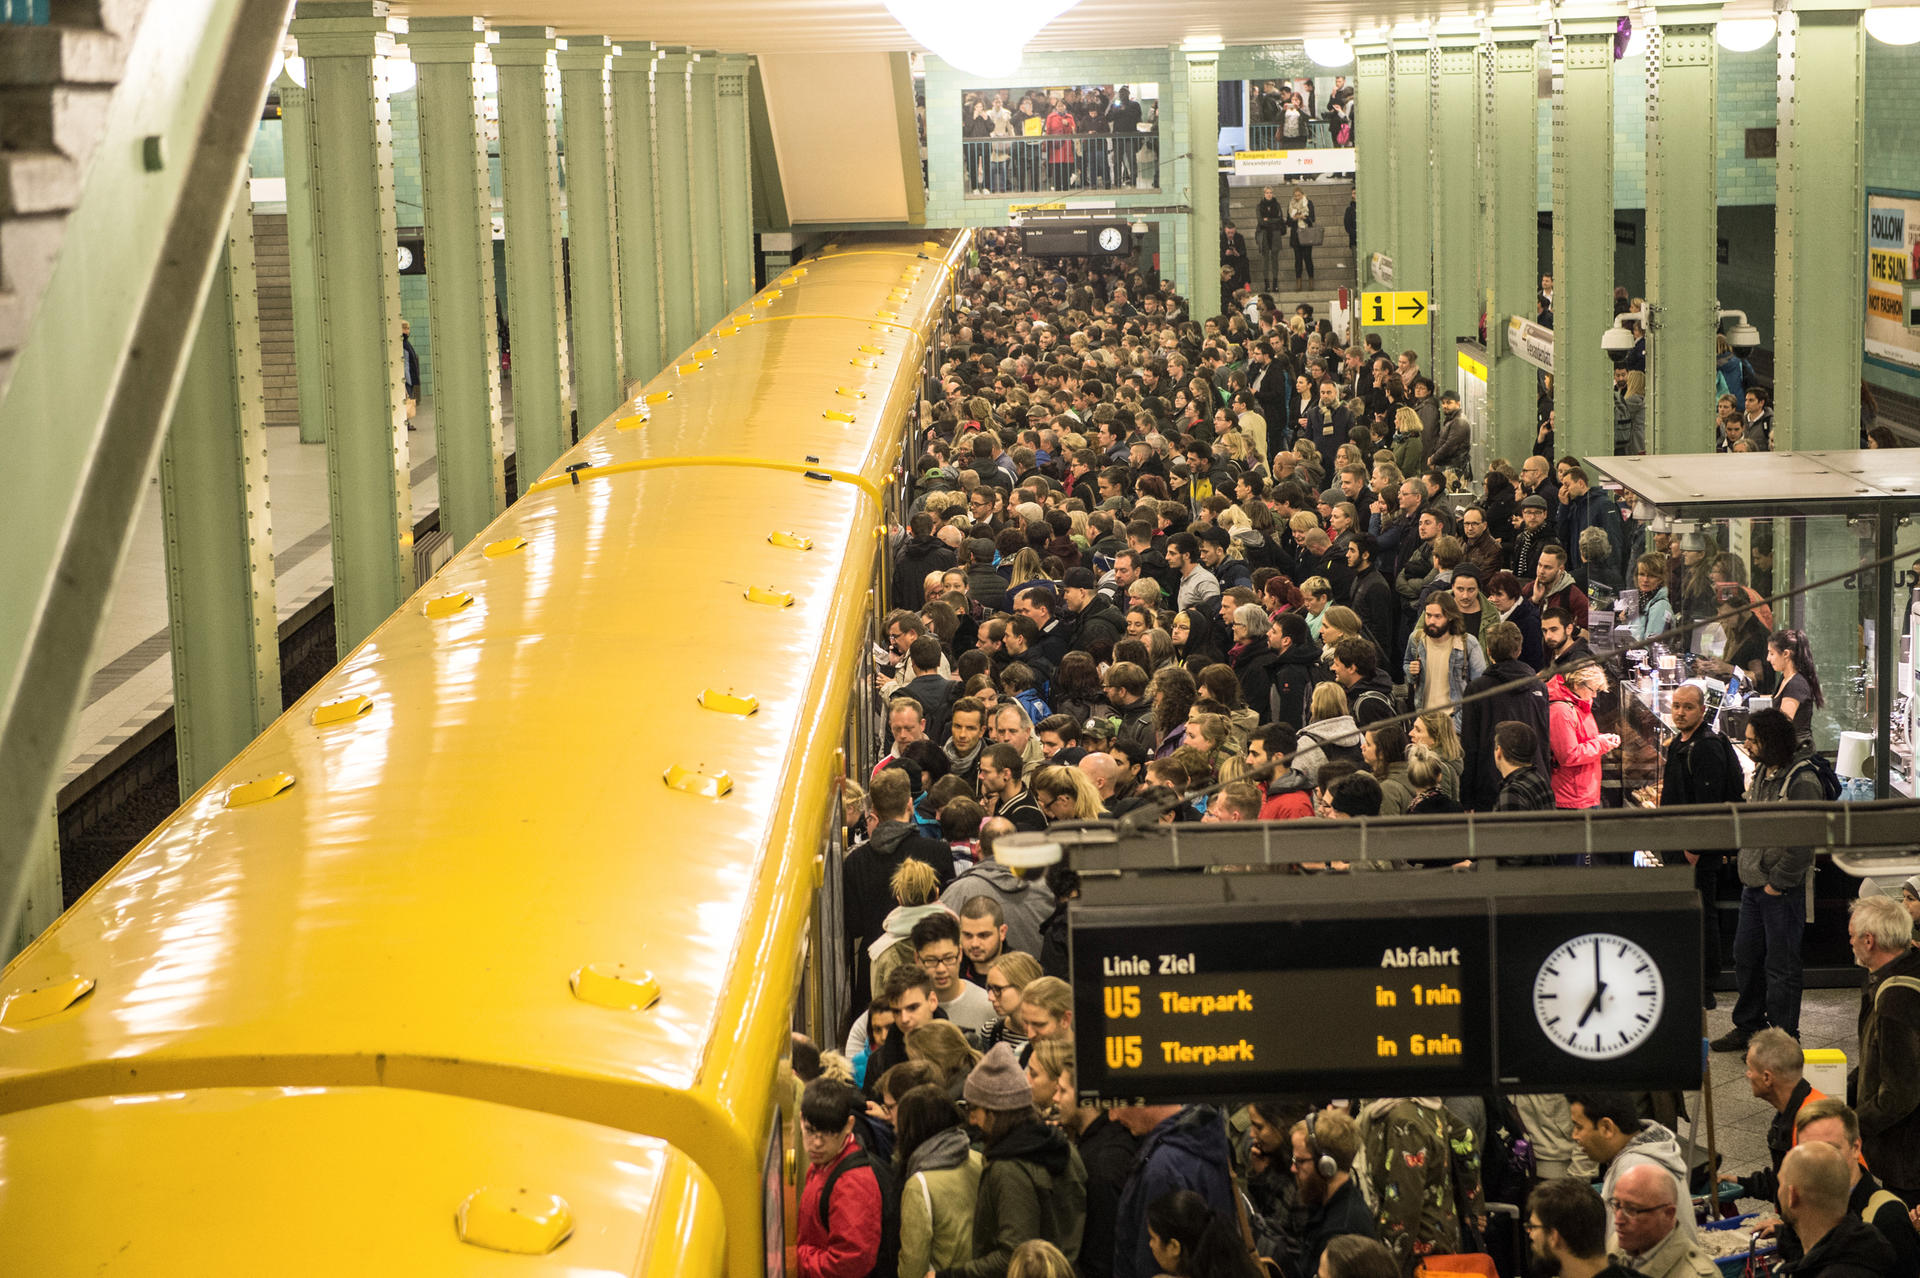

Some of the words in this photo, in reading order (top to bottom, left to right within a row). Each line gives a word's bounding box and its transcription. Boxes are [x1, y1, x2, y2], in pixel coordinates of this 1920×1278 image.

[1872, 214, 1904, 242] FOLLOW
[1872, 252, 1886, 280] THE
[1888, 255, 1906, 282] SUN
[1868, 294, 1880, 311] NOT
[1103, 955, 1151, 977] Linie
[1158, 953, 1196, 975] Ziel
[1381, 946, 1461, 968] Abfahrt
[1103, 985, 1142, 1019] U5
[1159, 989, 1254, 1016] Tierpark
[1375, 985, 1397, 1007] in
[1105, 1035, 1143, 1069] U5
[1160, 1039, 1255, 1066] Tierpark
[1376, 1035, 1398, 1057] in
